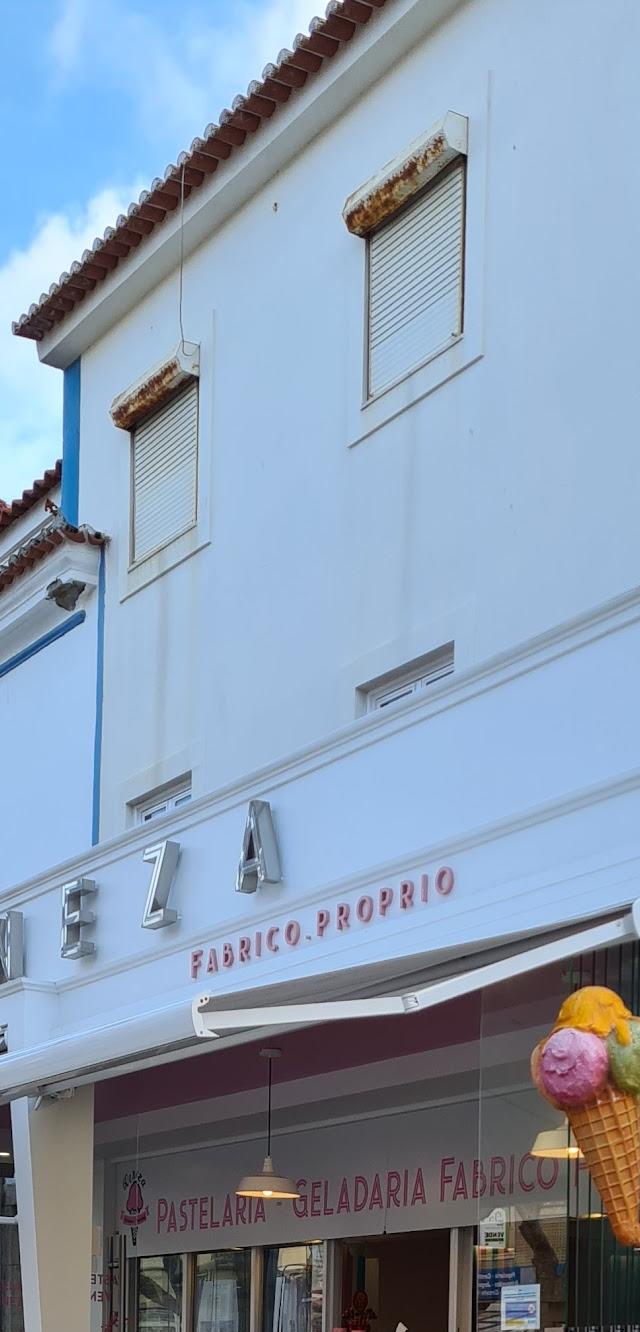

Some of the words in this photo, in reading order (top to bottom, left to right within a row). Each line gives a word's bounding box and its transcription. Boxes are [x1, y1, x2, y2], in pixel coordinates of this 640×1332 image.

[156, 1193, 266, 1234] PASTELARIA
[292, 1167, 427, 1218] GELADARIA
[439, 1152, 559, 1202] FABRICO
